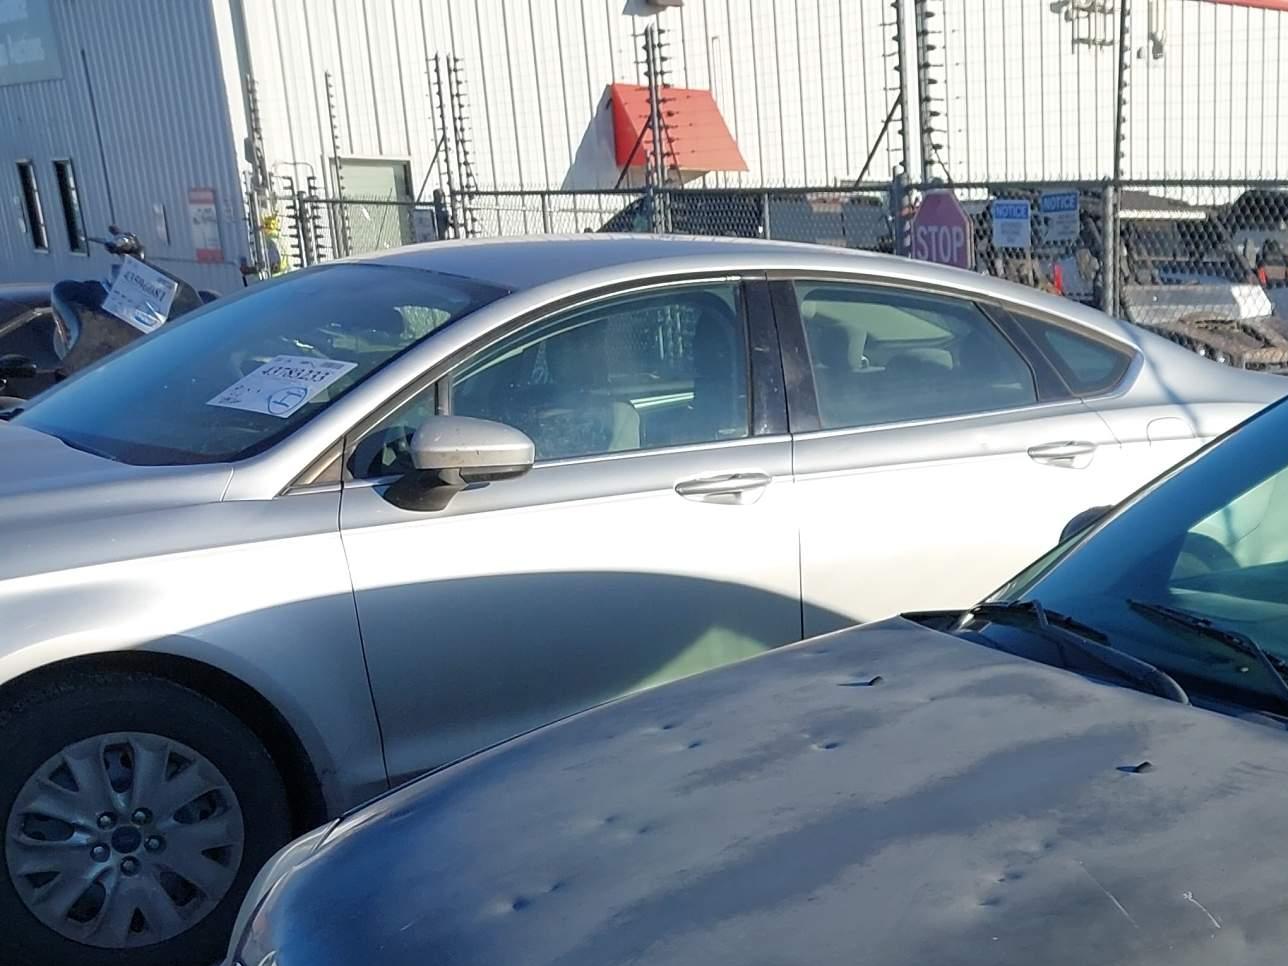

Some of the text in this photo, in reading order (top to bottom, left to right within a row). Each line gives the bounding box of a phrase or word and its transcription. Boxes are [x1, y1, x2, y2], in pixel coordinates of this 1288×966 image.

[1044, 195, 1076, 210] NOTICE
[996, 206, 1027, 217] NOTICE
[916, 225, 964, 264] STOP
